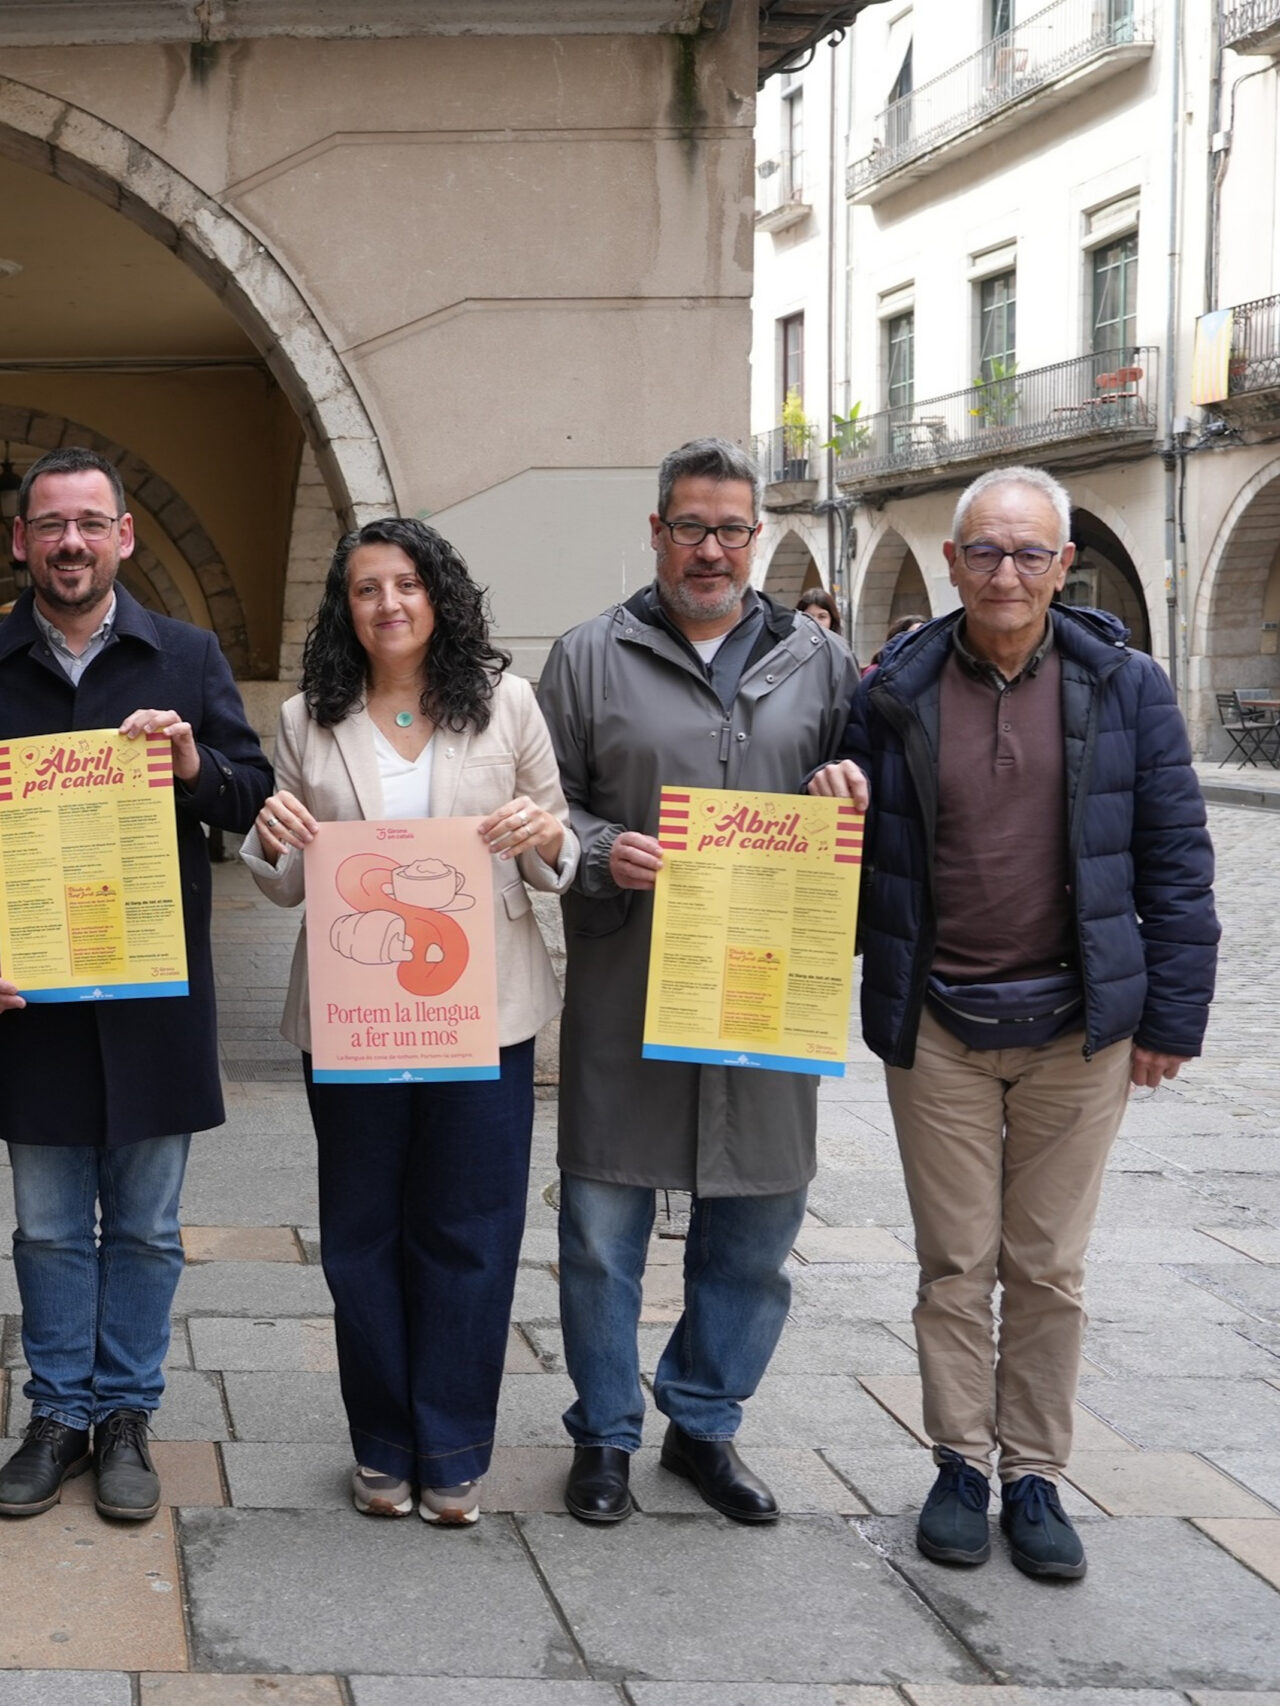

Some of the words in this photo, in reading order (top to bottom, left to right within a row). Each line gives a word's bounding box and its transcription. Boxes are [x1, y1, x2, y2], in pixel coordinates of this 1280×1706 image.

[35, 746, 113, 776] Abril
[22, 772, 57, 799] pel
[61, 767, 125, 789] català
[714, 806, 801, 836] Abril
[697, 829, 737, 852] pel
[739, 834, 809, 853] català
[327, 1003, 390, 1024] Portem
[395, 1002, 412, 1023] la
[416, 1001, 481, 1027] llengua
[351, 1032, 361, 1047] a
[365, 1025, 390, 1047] fer
[393, 1031, 417, 1046] un
[421, 1029, 458, 1046] mos
